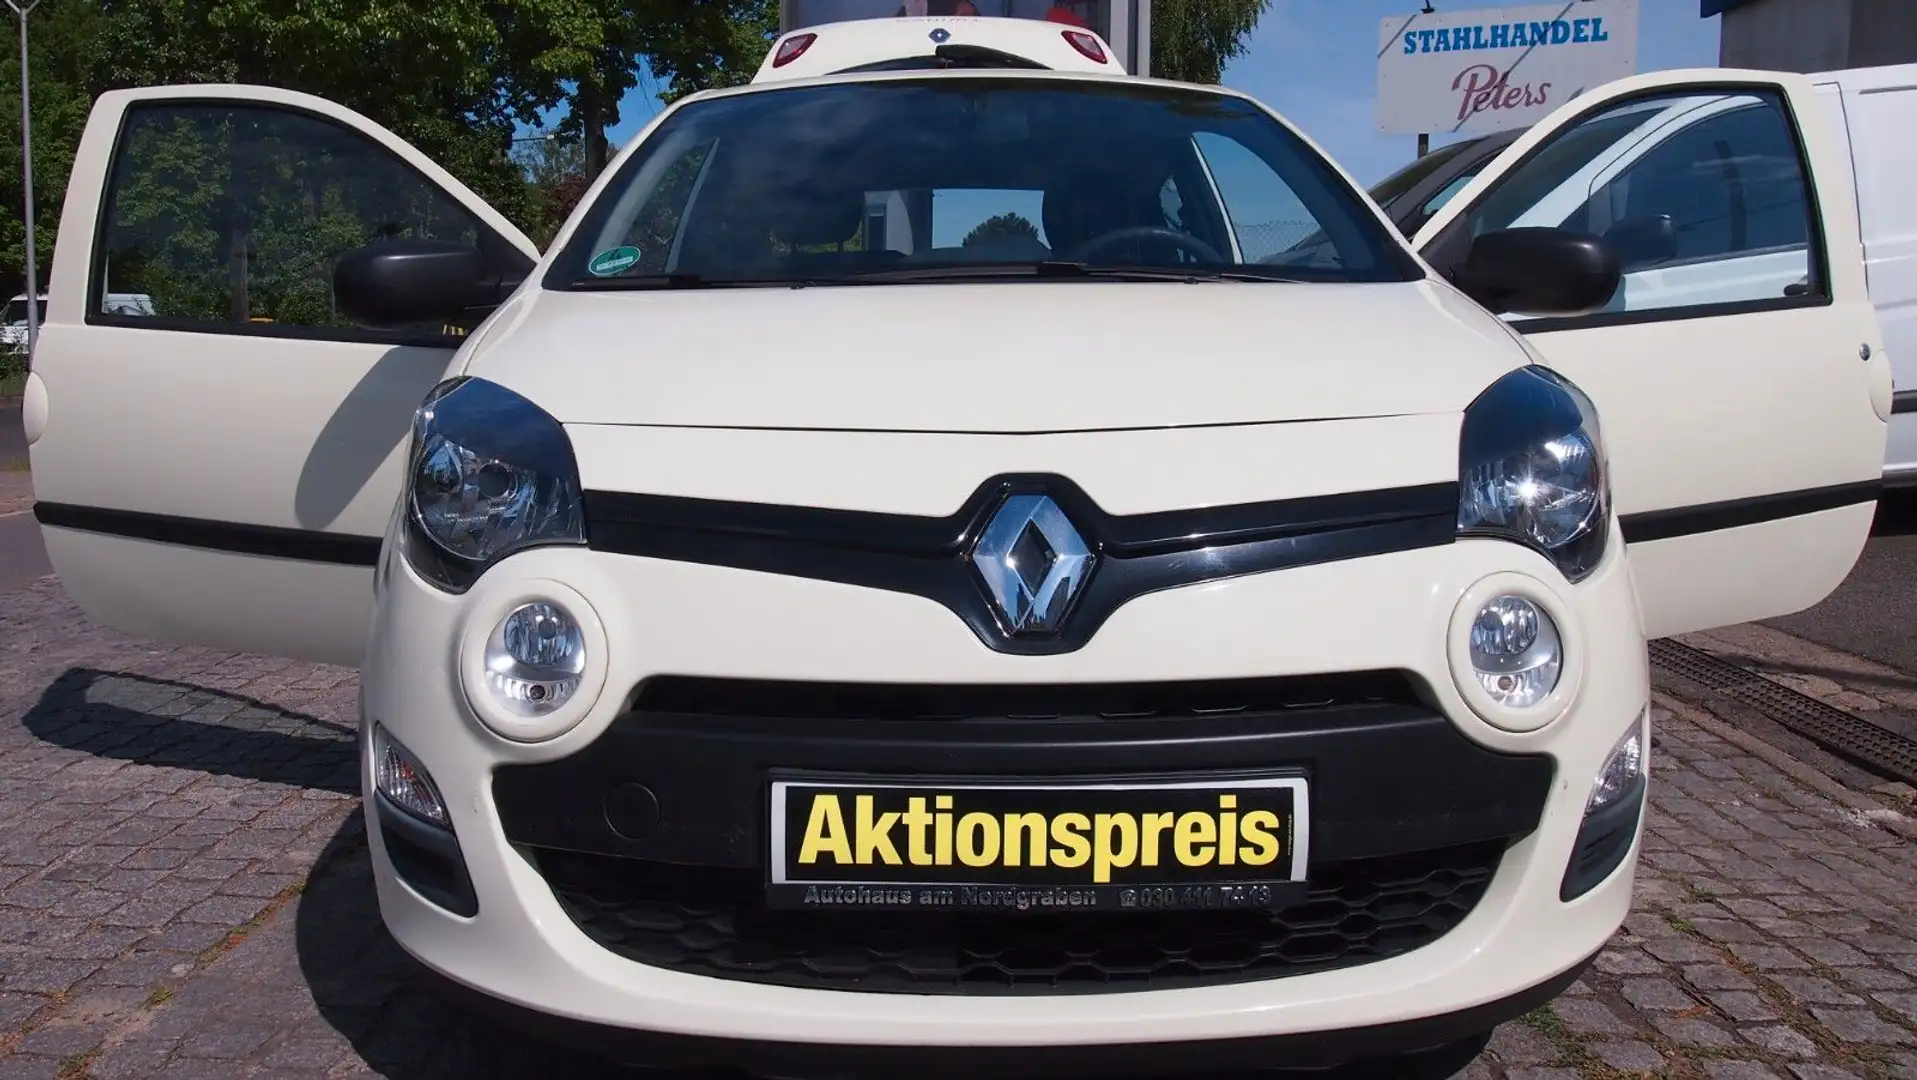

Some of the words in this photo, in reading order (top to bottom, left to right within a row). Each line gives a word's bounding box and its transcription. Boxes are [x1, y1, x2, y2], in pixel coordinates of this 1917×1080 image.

[1404, 17, 1608, 54] STAHLHANDEL
[1451, 64, 1551, 120] Peters
[798, 794, 1280, 883] Aktionspreis
[804, 885, 912, 904] Autohaus
[919, 890, 953, 905] am
[961, 886, 1097, 910] Nordgraben
